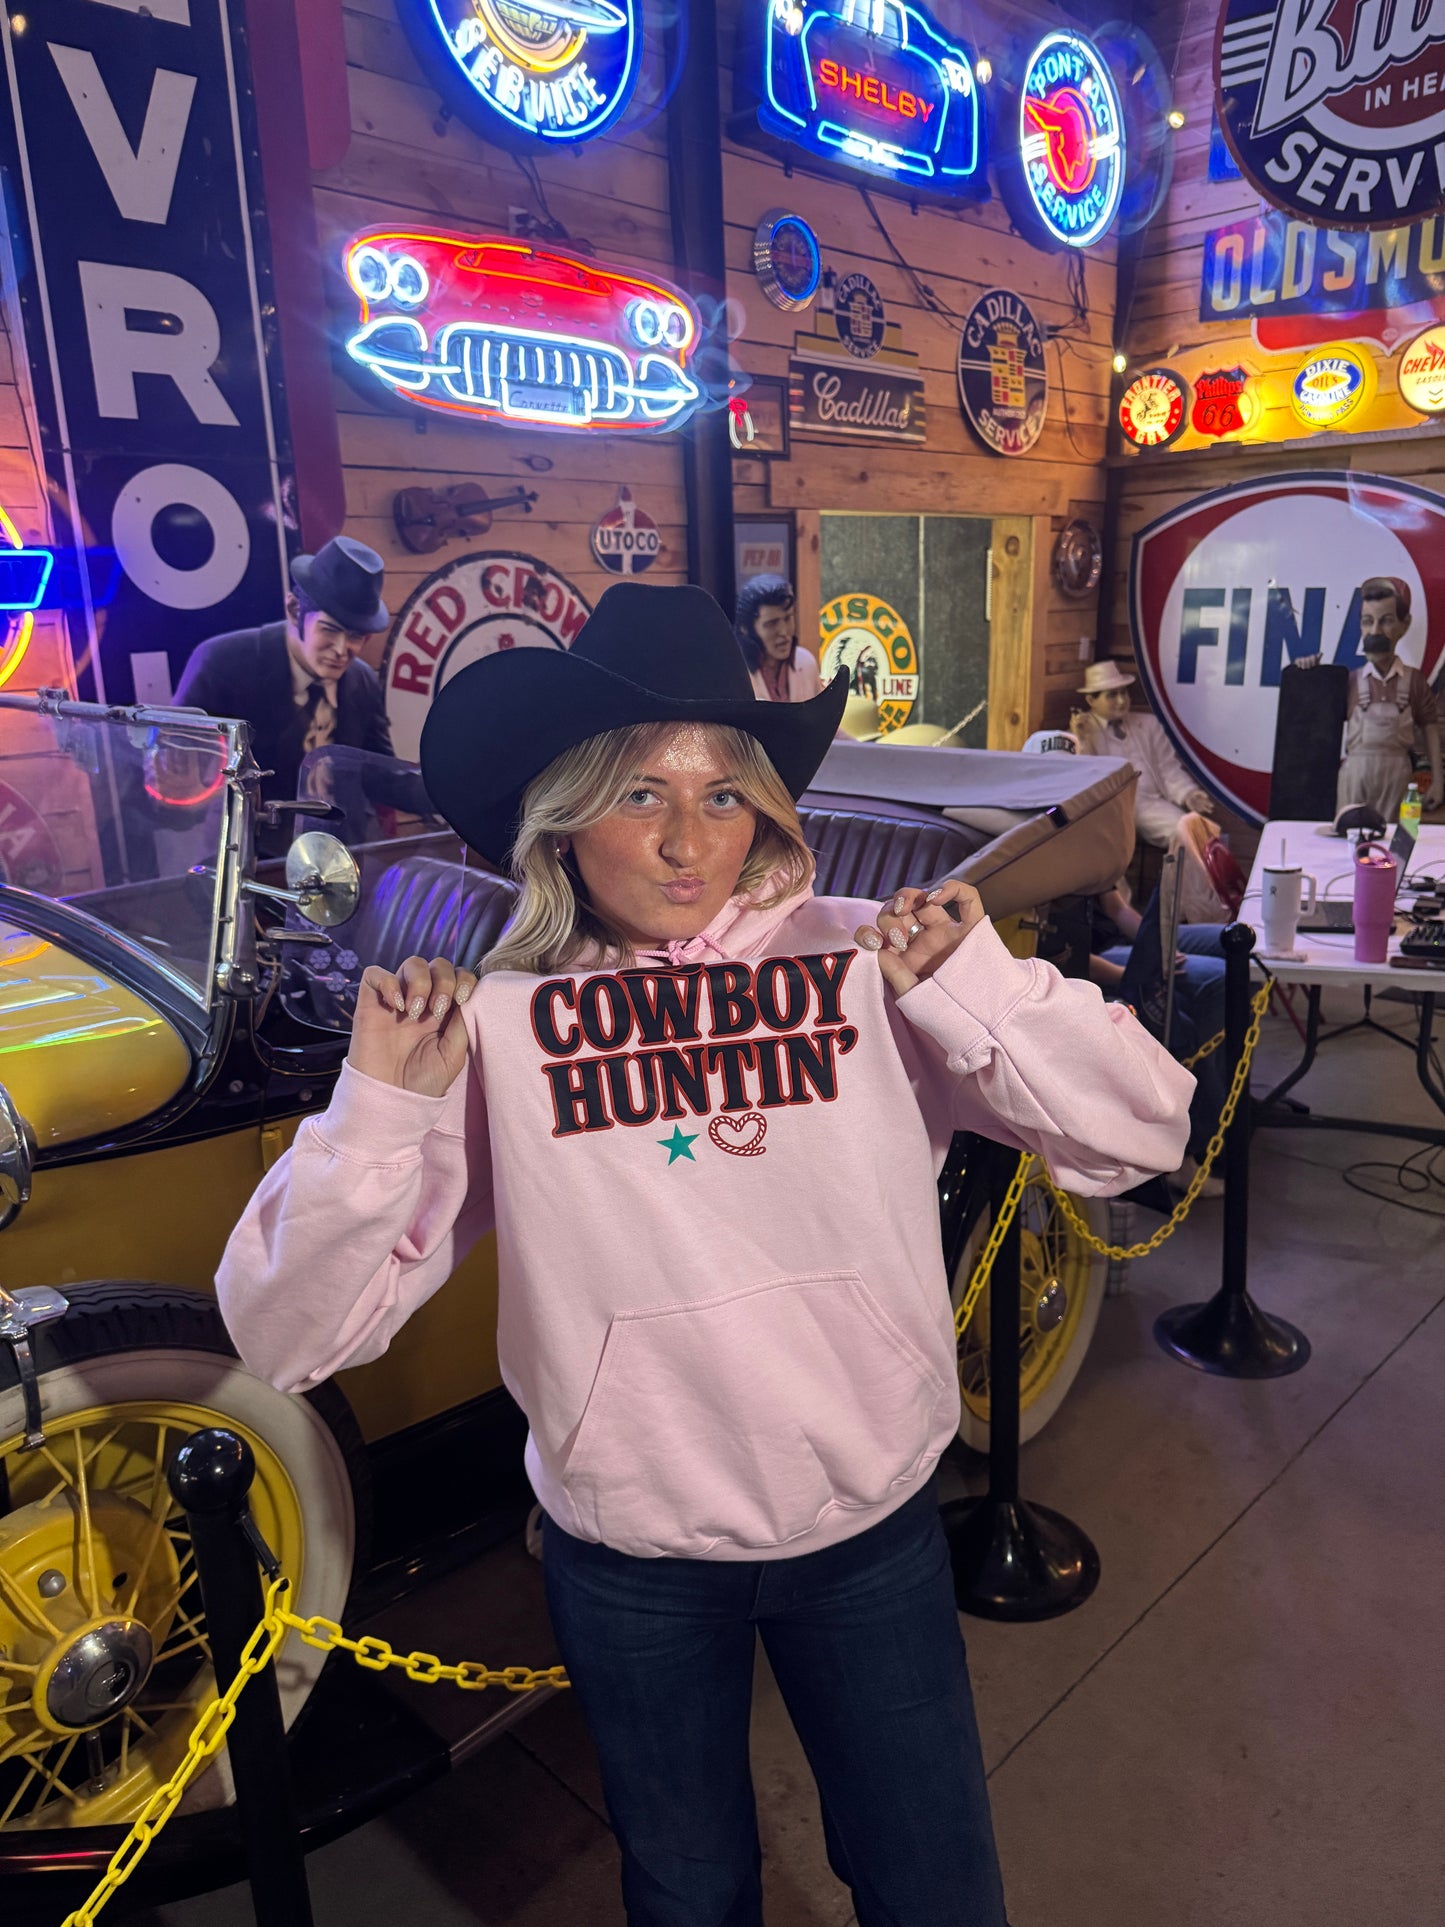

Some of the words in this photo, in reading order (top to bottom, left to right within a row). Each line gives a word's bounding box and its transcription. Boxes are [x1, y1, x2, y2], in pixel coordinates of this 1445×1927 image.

[453, 17, 607, 126] SERVICE
[817, 57, 935, 123] SHELBY
[1033, 50, 1110, 128] PONTAC
[1364, 84, 1392, 112] IN
[1030, 160, 1105, 229] SERVICE
[966, 295, 1042, 358] CADILLAC
[1120, 374, 1182, 410] FRONTIER
[1196, 377, 1243, 398] Phillips
[1304, 359, 1351, 378] DIXIE
[812, 371, 911, 430] Cadillac
[977, 408, 1039, 448] SERVICE
[1203, 403, 1236, 427] 66
[600, 530, 659, 551] UTOCO
[391, 585, 466, 697] RED
[882, 678, 913, 697] LINE
[530, 949, 858, 1058] COWBOY
[541, 1025, 859, 1138] HUNTIN'
